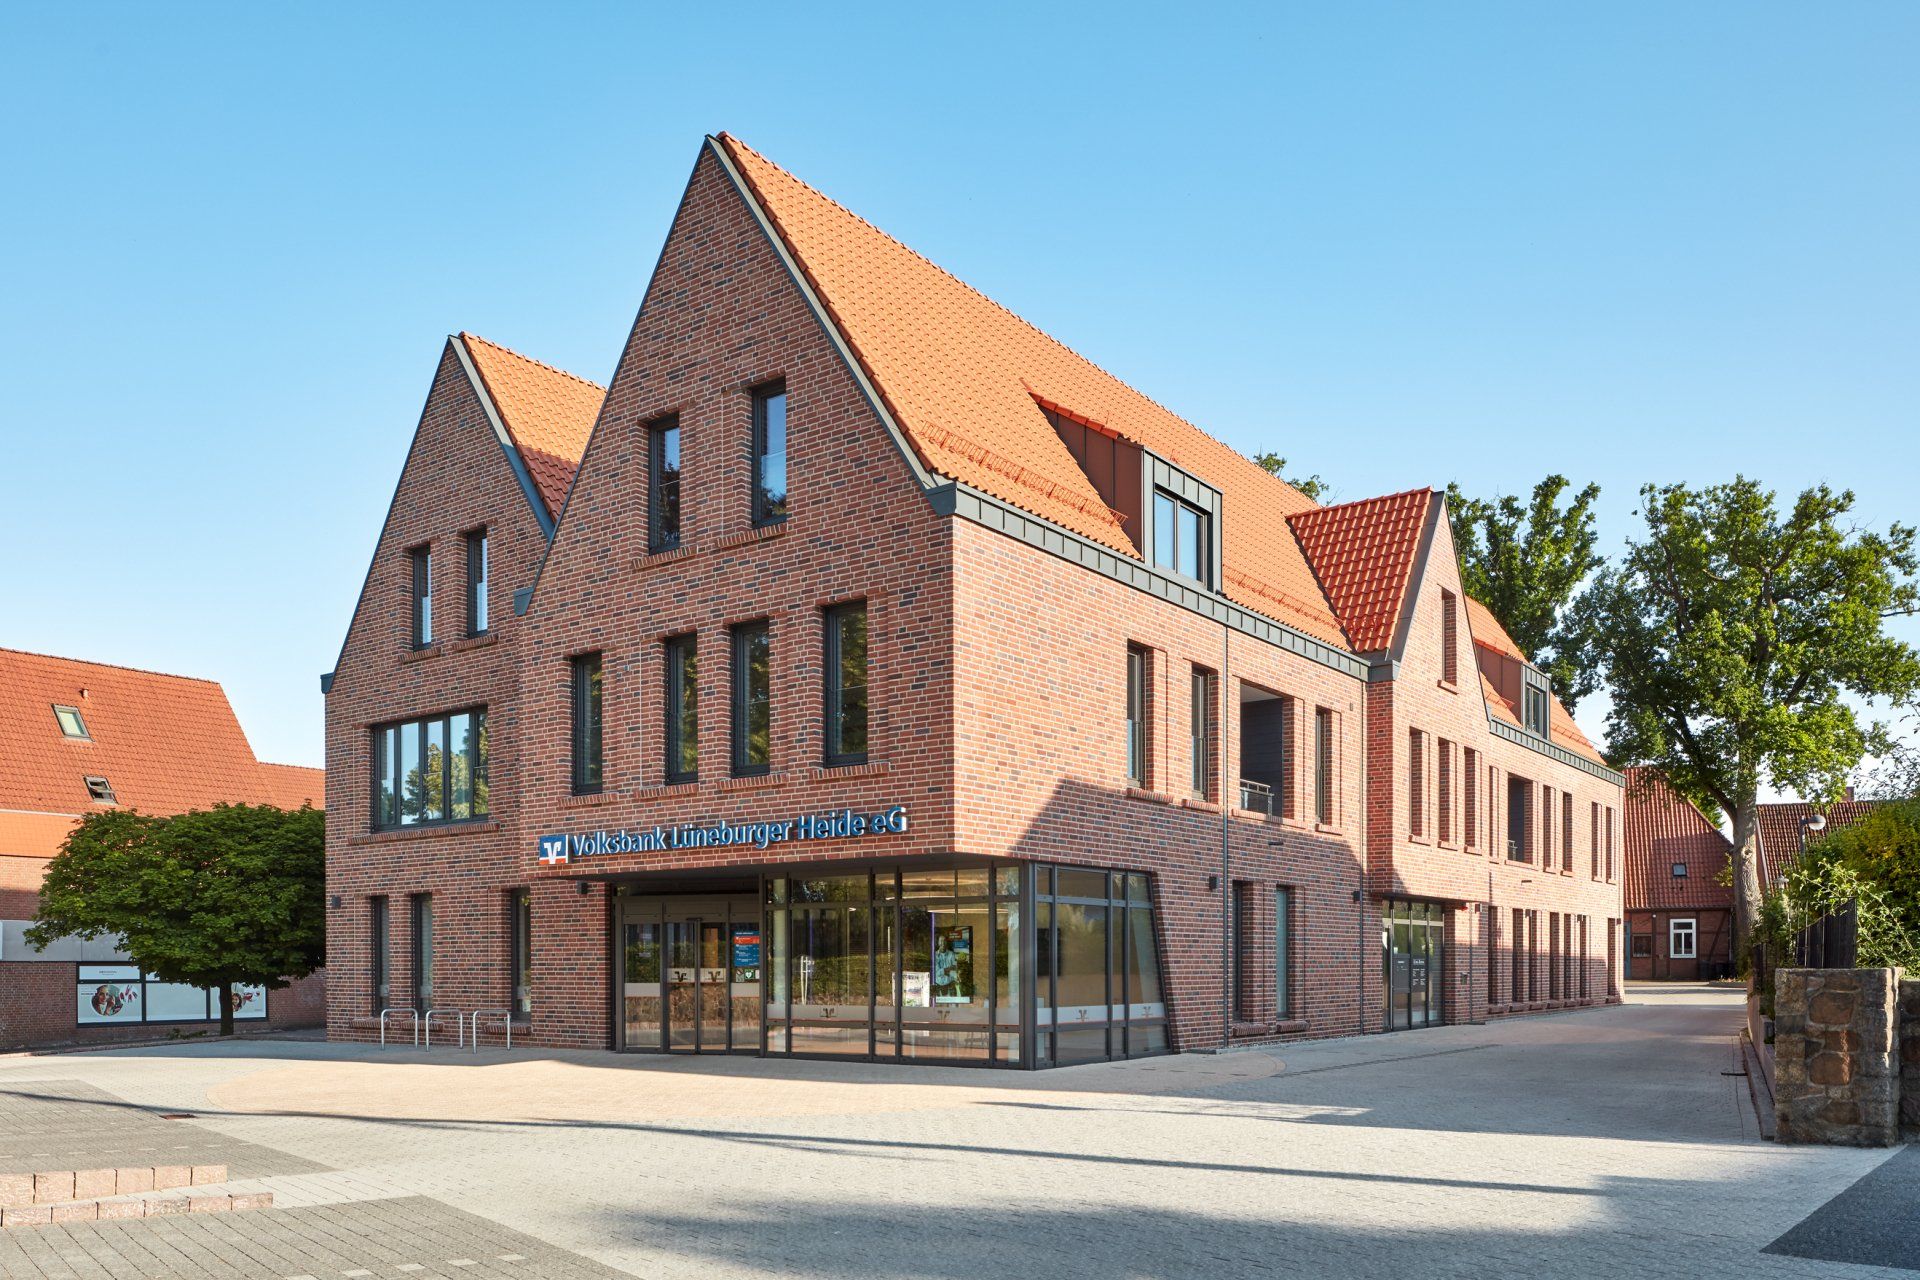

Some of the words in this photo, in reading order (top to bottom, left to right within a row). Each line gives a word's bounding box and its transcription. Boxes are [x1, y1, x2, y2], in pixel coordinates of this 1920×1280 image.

[571, 827, 667, 856] Volksbank
[671, 820, 793, 849] Lüneburger
[798, 810, 866, 839] Heide
[871, 806, 907, 834] eG
